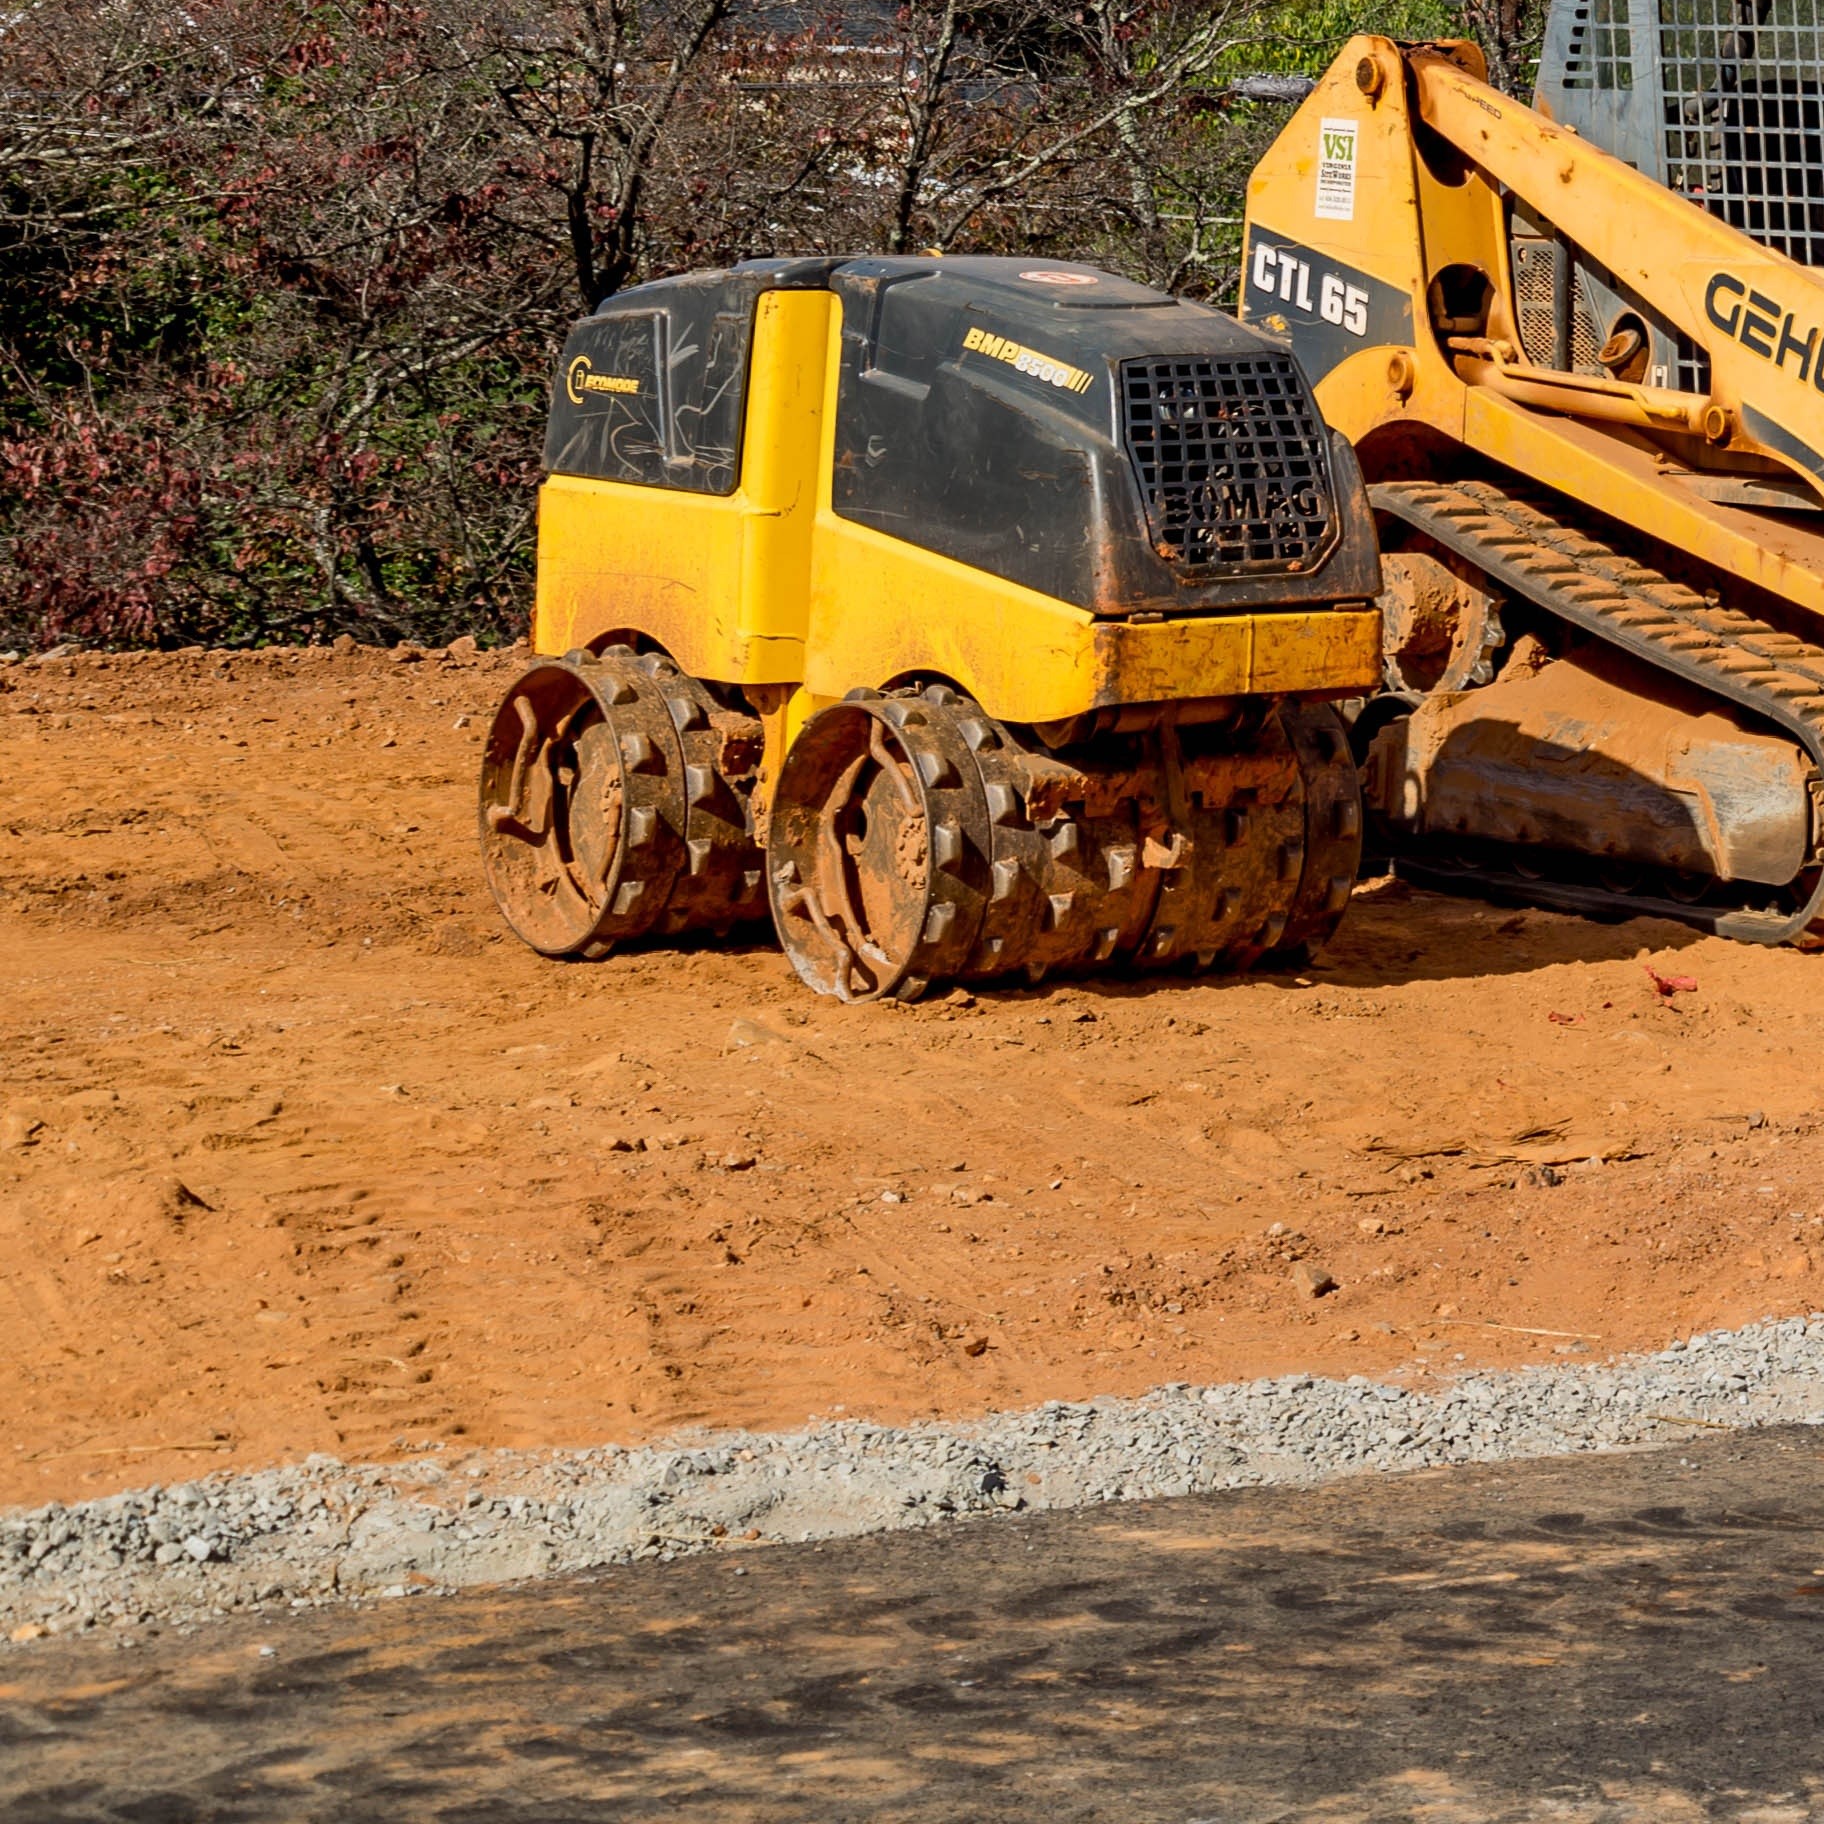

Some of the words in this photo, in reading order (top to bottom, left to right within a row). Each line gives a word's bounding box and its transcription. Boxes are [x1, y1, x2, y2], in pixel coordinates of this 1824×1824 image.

[1323, 133, 1354, 161] VSI
[1253, 242, 1313, 313] CTL
[1320, 273, 1369, 337] 65
[962, 327, 1020, 362] BMP
[1014, 353, 1068, 388] 8500
[584, 374, 640, 394] ECOMODE
[1163, 480, 1320, 524] BOMAG
